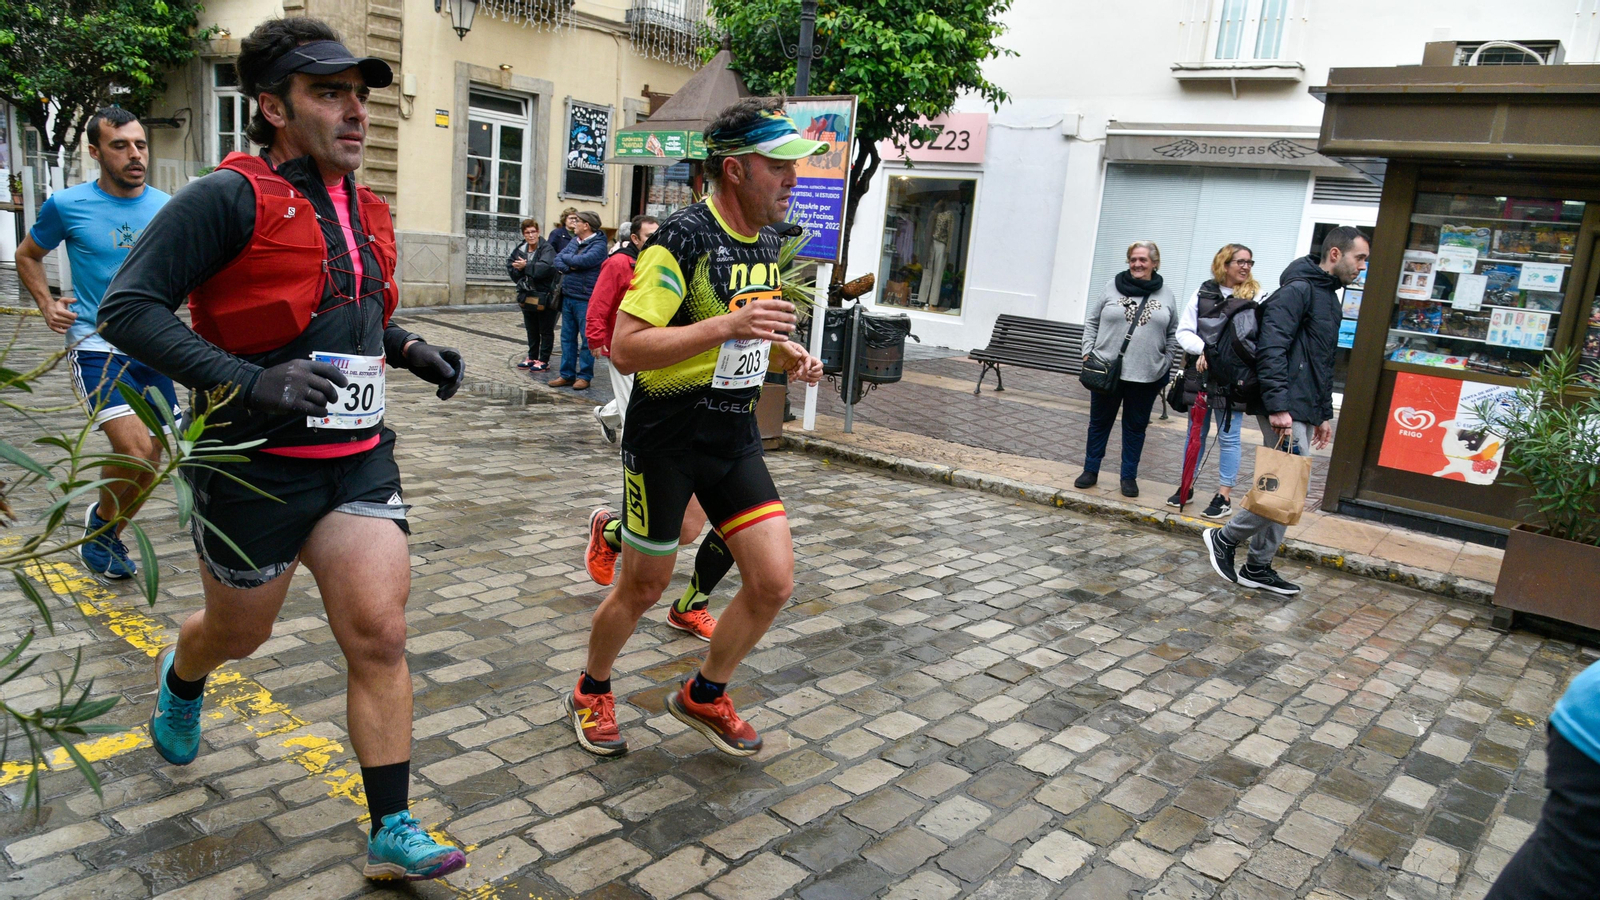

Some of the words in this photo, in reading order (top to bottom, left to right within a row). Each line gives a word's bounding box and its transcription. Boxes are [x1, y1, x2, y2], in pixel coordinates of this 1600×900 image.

[1200, 143, 1266, 157] 3negras
[825, 221, 840, 231] 2022
[733, 350, 760, 375] 203
[344, 383, 374, 411] 30
[1399, 429, 1422, 438] FRIGO
